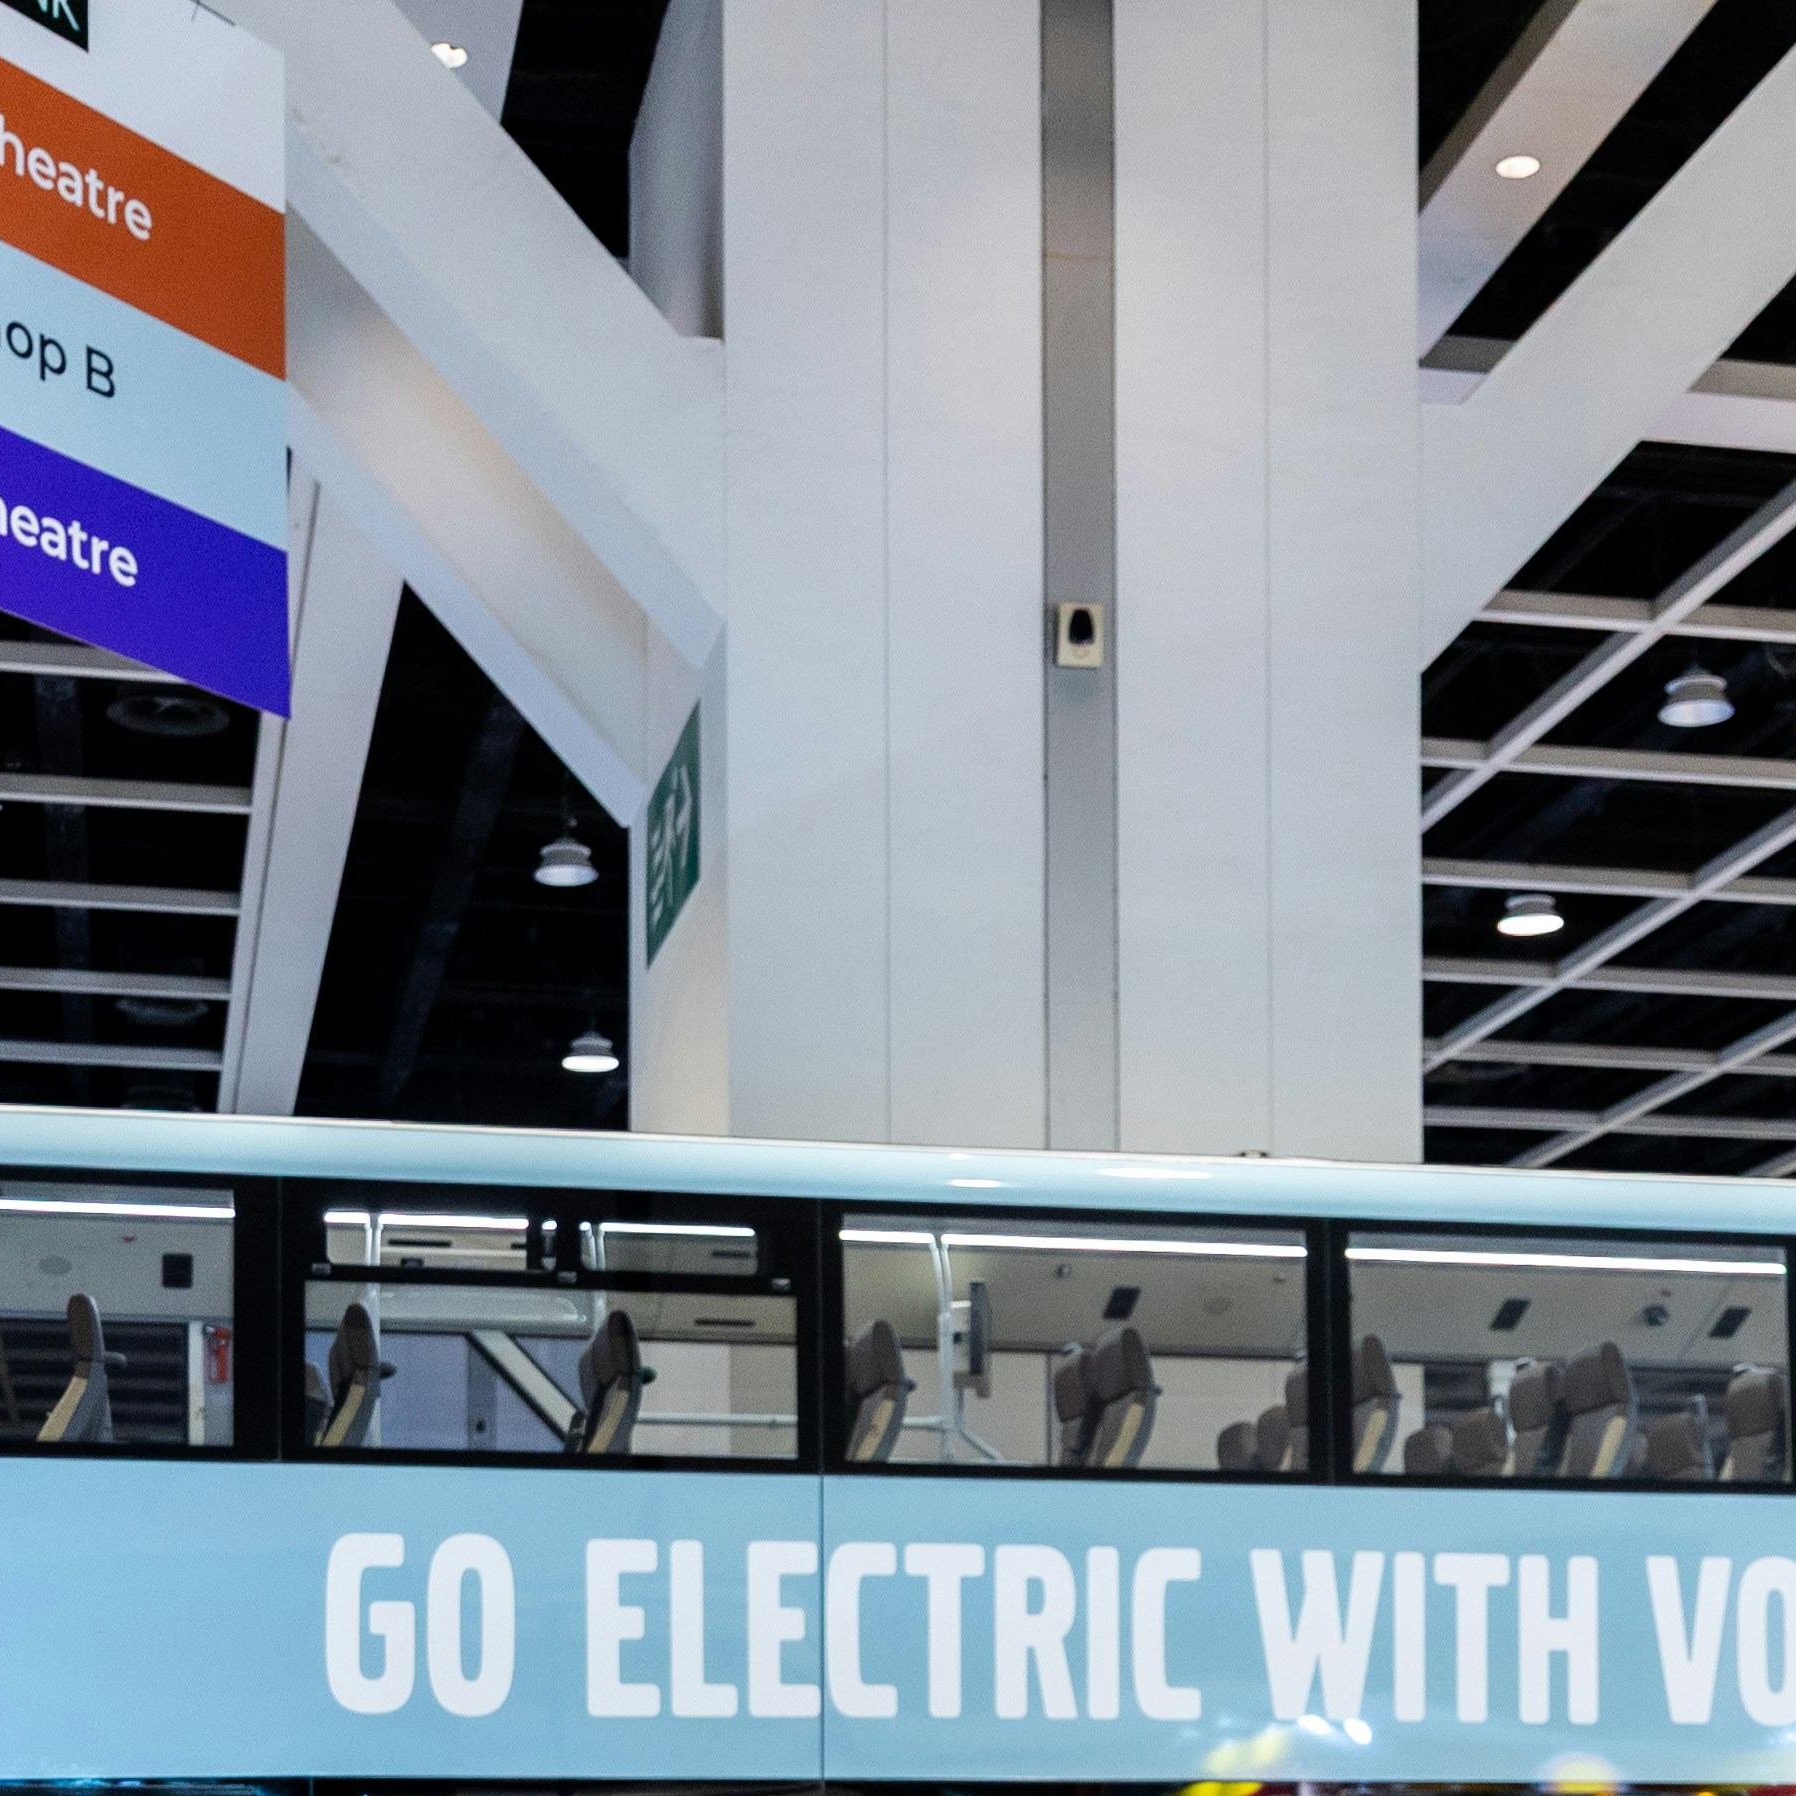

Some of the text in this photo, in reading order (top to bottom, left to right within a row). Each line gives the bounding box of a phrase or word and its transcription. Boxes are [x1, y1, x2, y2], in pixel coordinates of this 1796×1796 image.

[86, 346, 117, 399] B
[325, 1531, 516, 1718] GO
[585, 1536, 1203, 1722] ELECTRIC
[1249, 1547, 1600, 1726] WITH
